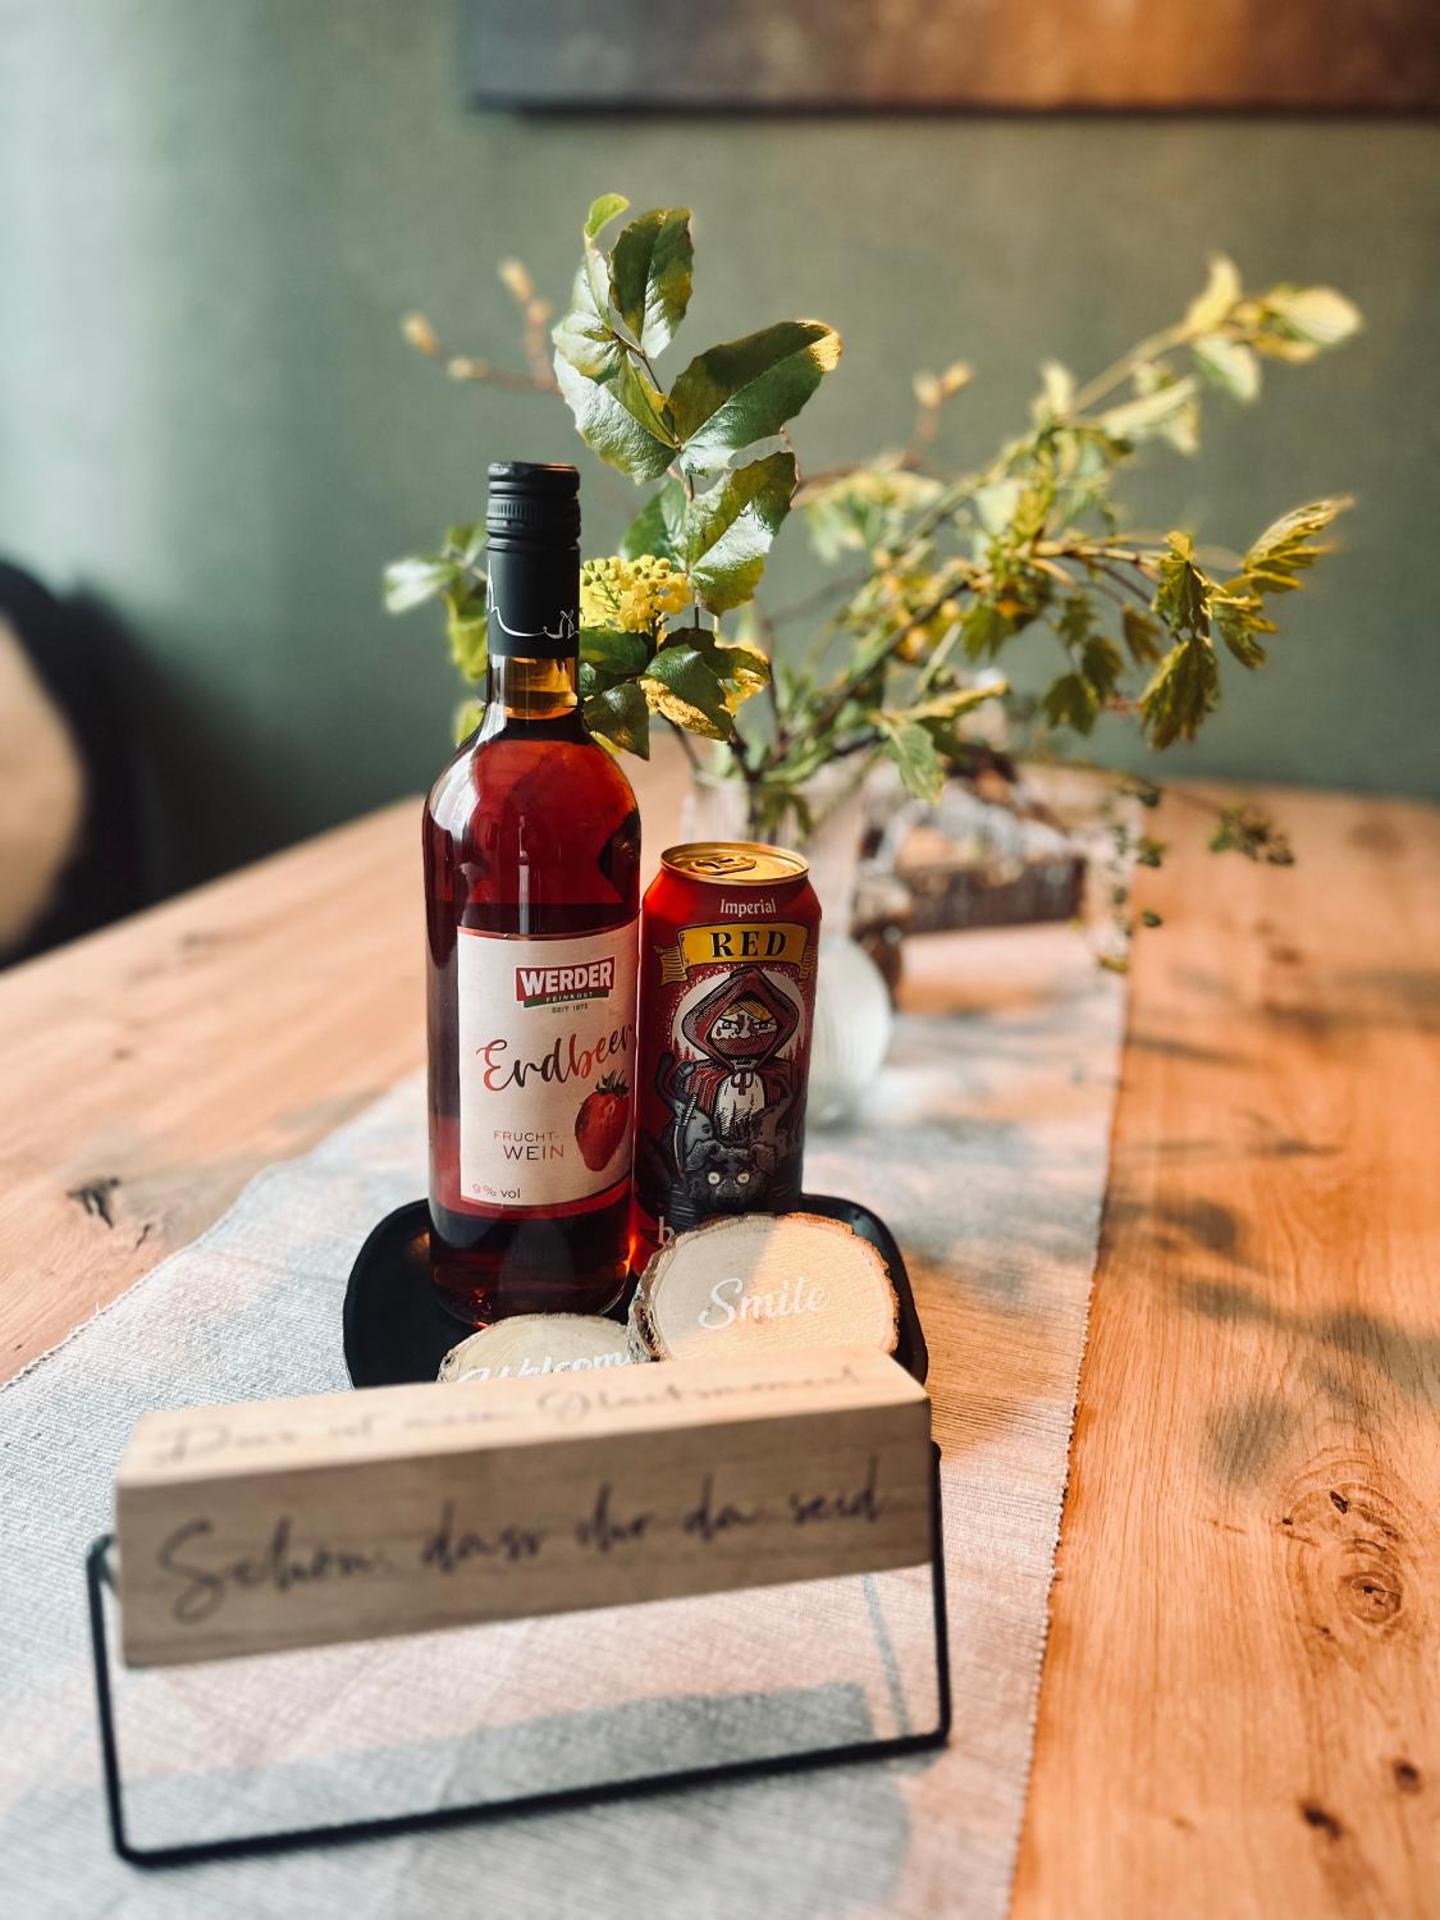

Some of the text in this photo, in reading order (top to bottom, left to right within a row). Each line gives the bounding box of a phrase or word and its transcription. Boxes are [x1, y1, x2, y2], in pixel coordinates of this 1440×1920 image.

[719, 897, 777, 917] Imperial
[710, 930, 787, 958] RED
[520, 961, 613, 997] WERDER
[476, 1023, 632, 1091] Erdbeer
[503, 1144, 564, 1160] WEIN
[501, 1188, 521, 1199] vol
[700, 1277, 828, 1329] Smile
